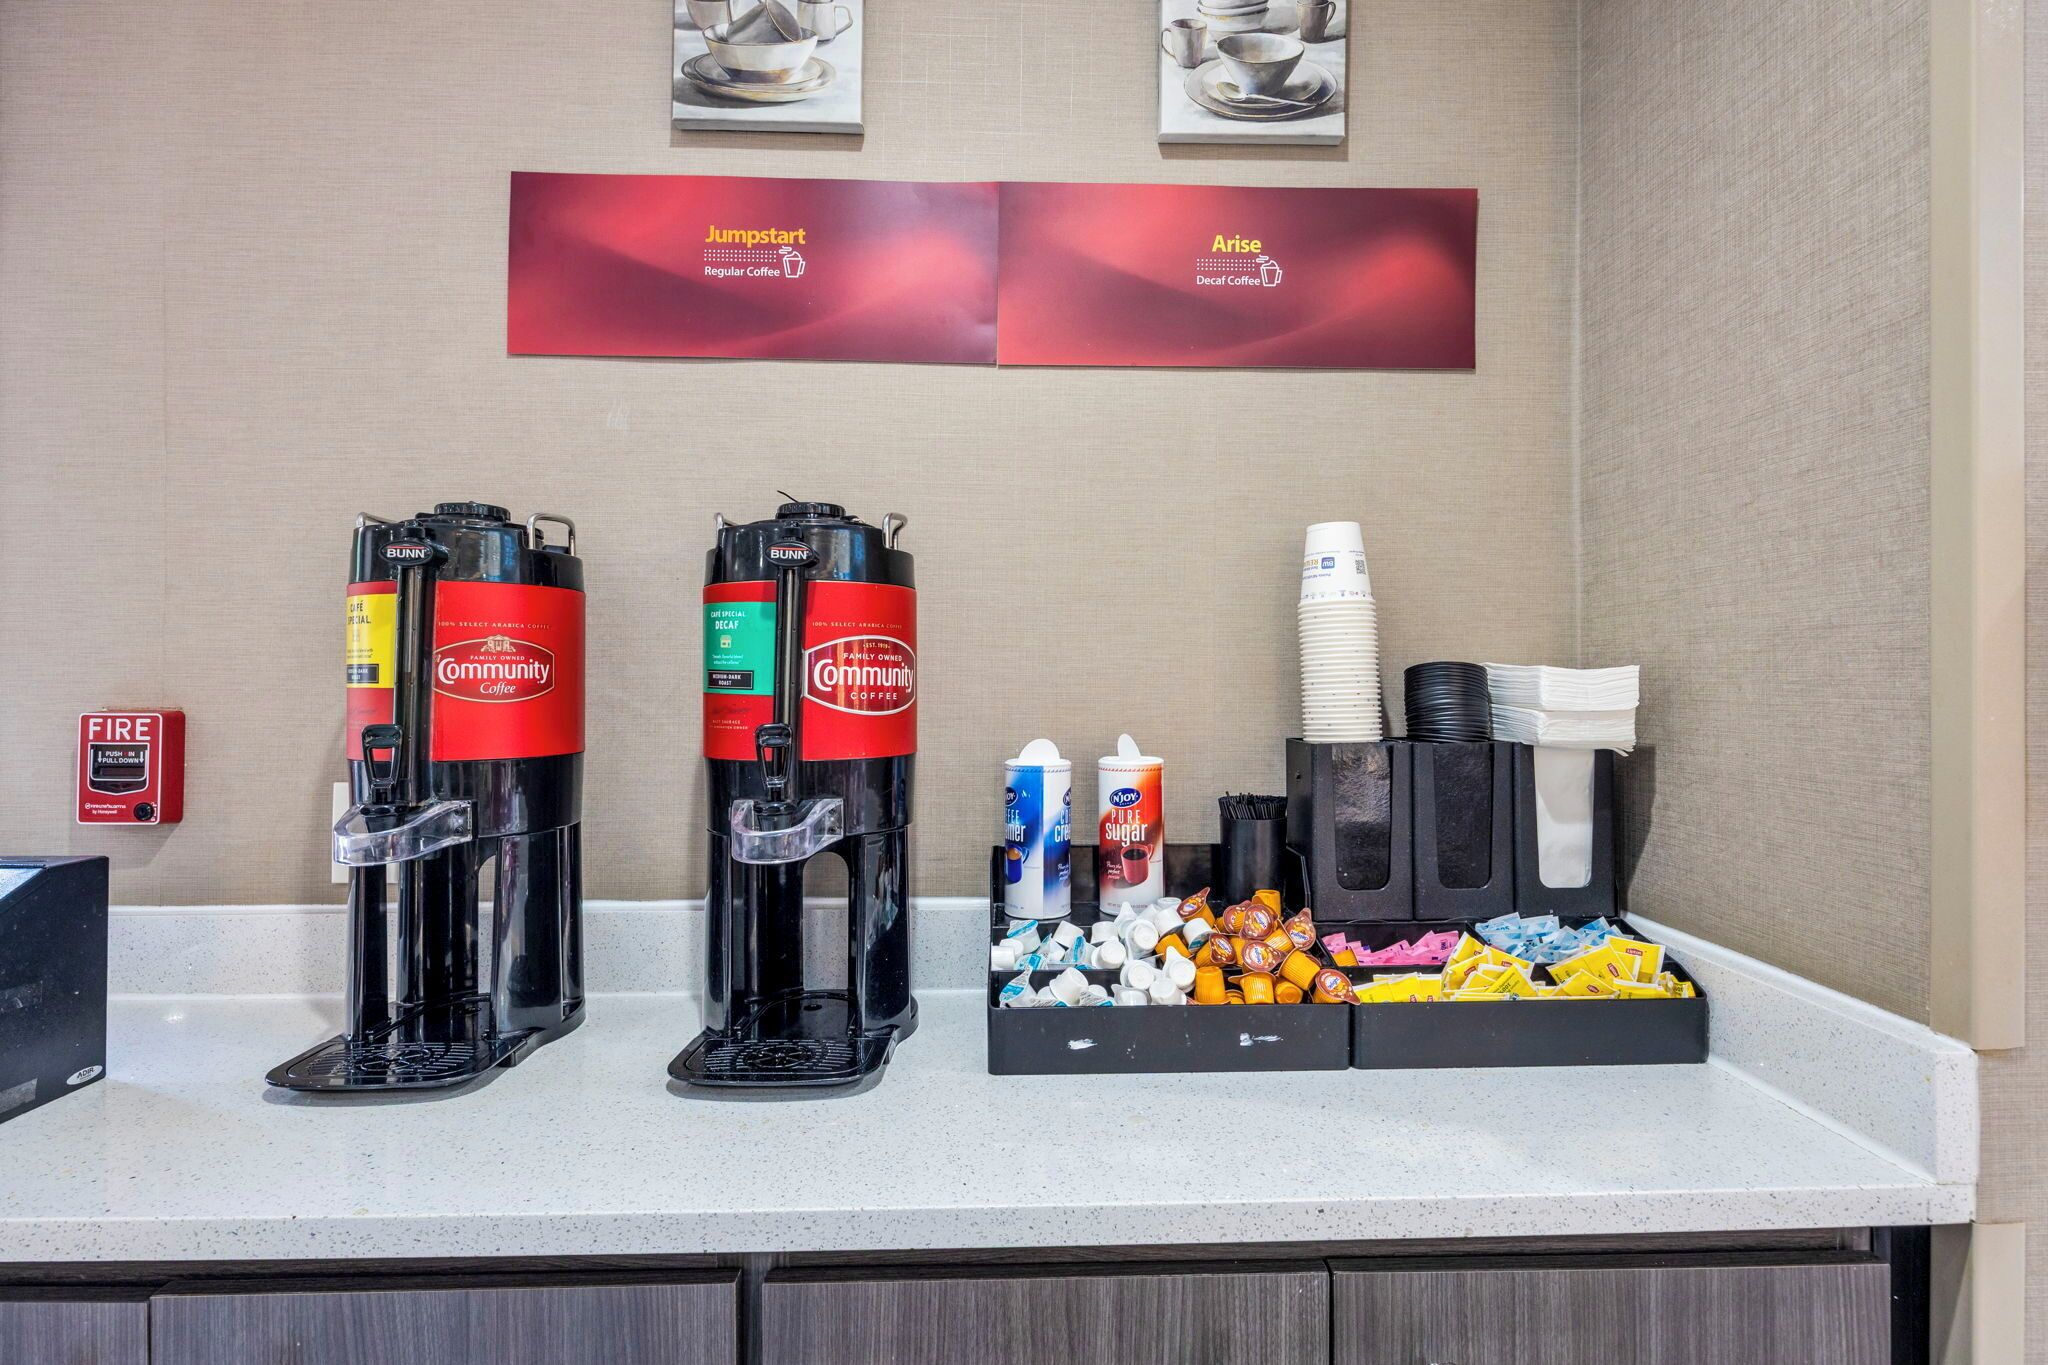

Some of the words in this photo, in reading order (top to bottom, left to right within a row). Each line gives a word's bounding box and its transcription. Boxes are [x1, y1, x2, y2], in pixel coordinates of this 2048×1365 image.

[705, 225, 806, 248] Jumpstart
[1211, 234, 1262, 253] Arise
[704, 266, 745, 278] Regular
[746, 266, 780, 277] Coffee
[1196, 275, 1226, 285] Decaf
[1227, 276, 1260, 286] Coffee
[386, 548, 425, 559] BUNN
[770, 549, 807, 560] BUNN
[710, 609, 721, 618] CAFÉ
[715, 620, 739, 630] DECAF
[843, 652, 875, 660] FAMILY
[877, 654, 902, 662] OWNED
[437, 657, 550, 685] Community
[813, 658, 914, 693] Community
[480, 681, 517, 696] Coffee
[850, 692, 898, 700] COFFEE
[88, 718, 152, 740] FIRE
[1111, 808, 1141, 824] PURE
[1105, 822, 1148, 848] sugar
[76, 1066, 94, 1079] ADIR
